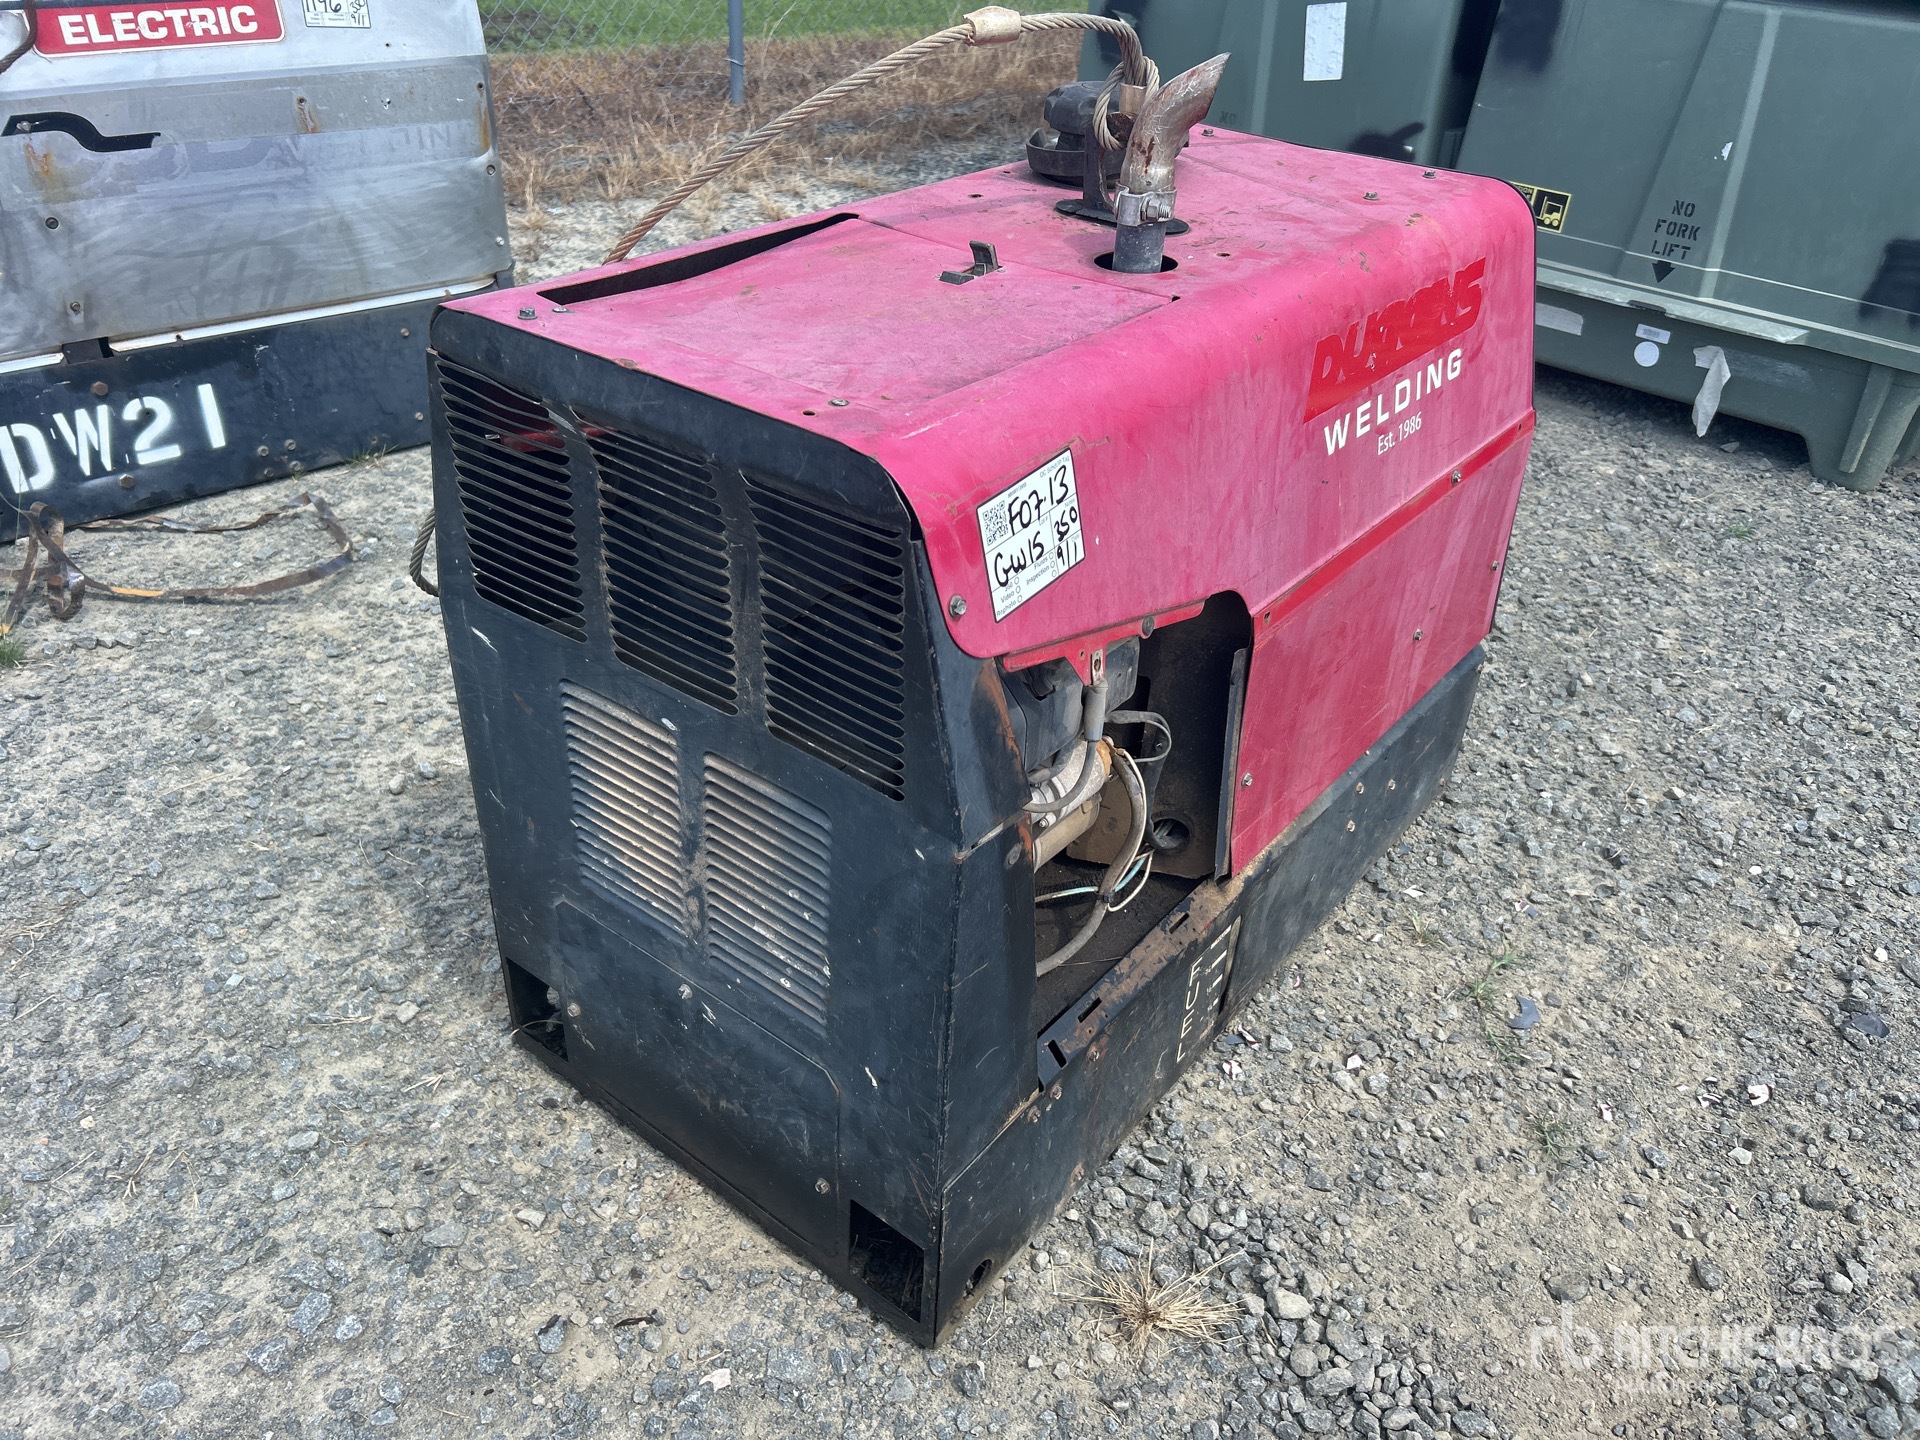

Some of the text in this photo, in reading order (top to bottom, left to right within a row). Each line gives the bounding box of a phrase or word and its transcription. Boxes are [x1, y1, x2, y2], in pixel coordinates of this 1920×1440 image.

[58, 5, 259, 45] ELECTRIC
[1672, 200, 1696, 218] NO
[1651, 239, 1692, 260] LIFT
[1654, 218, 1701, 242] FORK
[1323, 348, 1462, 456] WELDING
[0, 383, 226, 494] DW21
[1377, 411, 1423, 456] Est. 1986
[1026, 565, 1049, 586] Inspection
[1176, 957, 1203, 1063] FUEL
